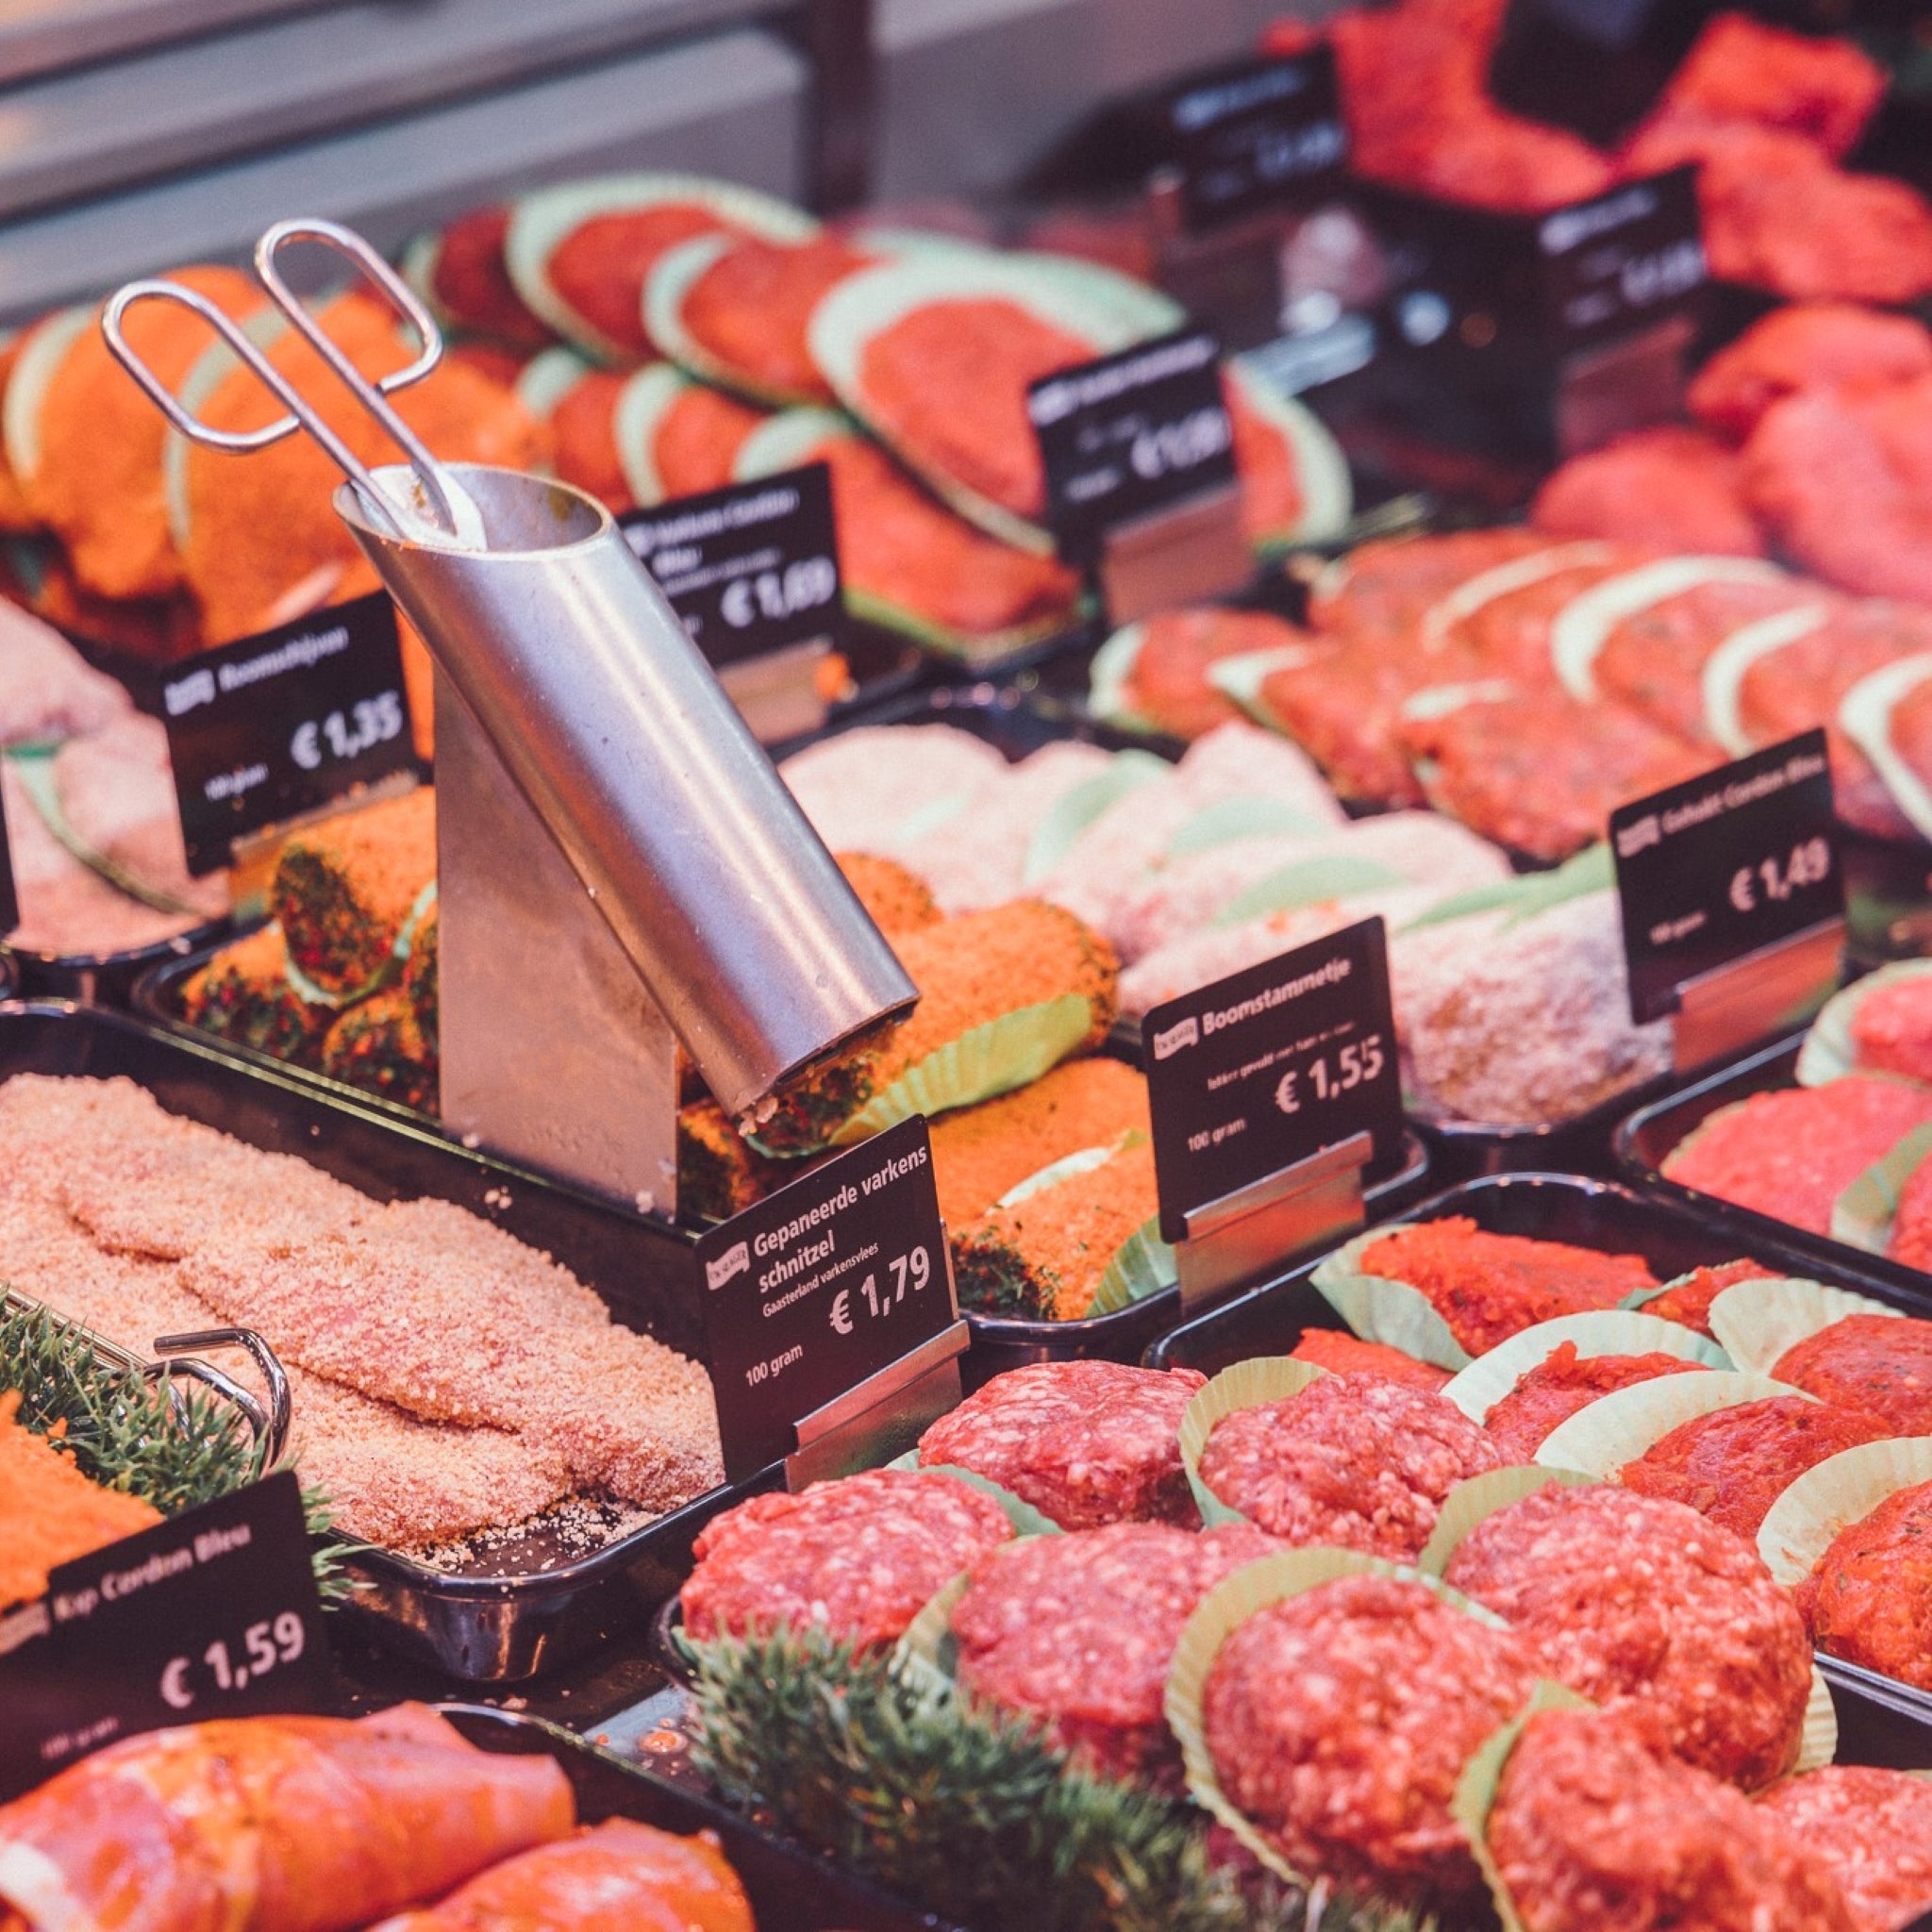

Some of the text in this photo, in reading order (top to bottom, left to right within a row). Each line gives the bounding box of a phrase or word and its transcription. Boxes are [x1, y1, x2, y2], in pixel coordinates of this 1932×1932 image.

[721, 577, 754, 628] €
[290, 689, 403, 770] € 1,35
[1730, 836, 1829, 912] € 1,49
[1203, 958, 1352, 1036] Boomstammetje
[1275, 1034, 1384, 1114] € 1,55
[1187, 1118, 1246, 1152] 100 gram
[754, 1145, 927, 1257] Gepaneerde varkens
[758, 1229, 836, 1294] schnitzel
[762, 1241, 879, 1318] Gaasterland varkensvlees
[829, 1245, 930, 1335] € 1,79
[745, 1343, 803, 1387] 100 gram
[160, 1610, 305, 1708] € 1,59
